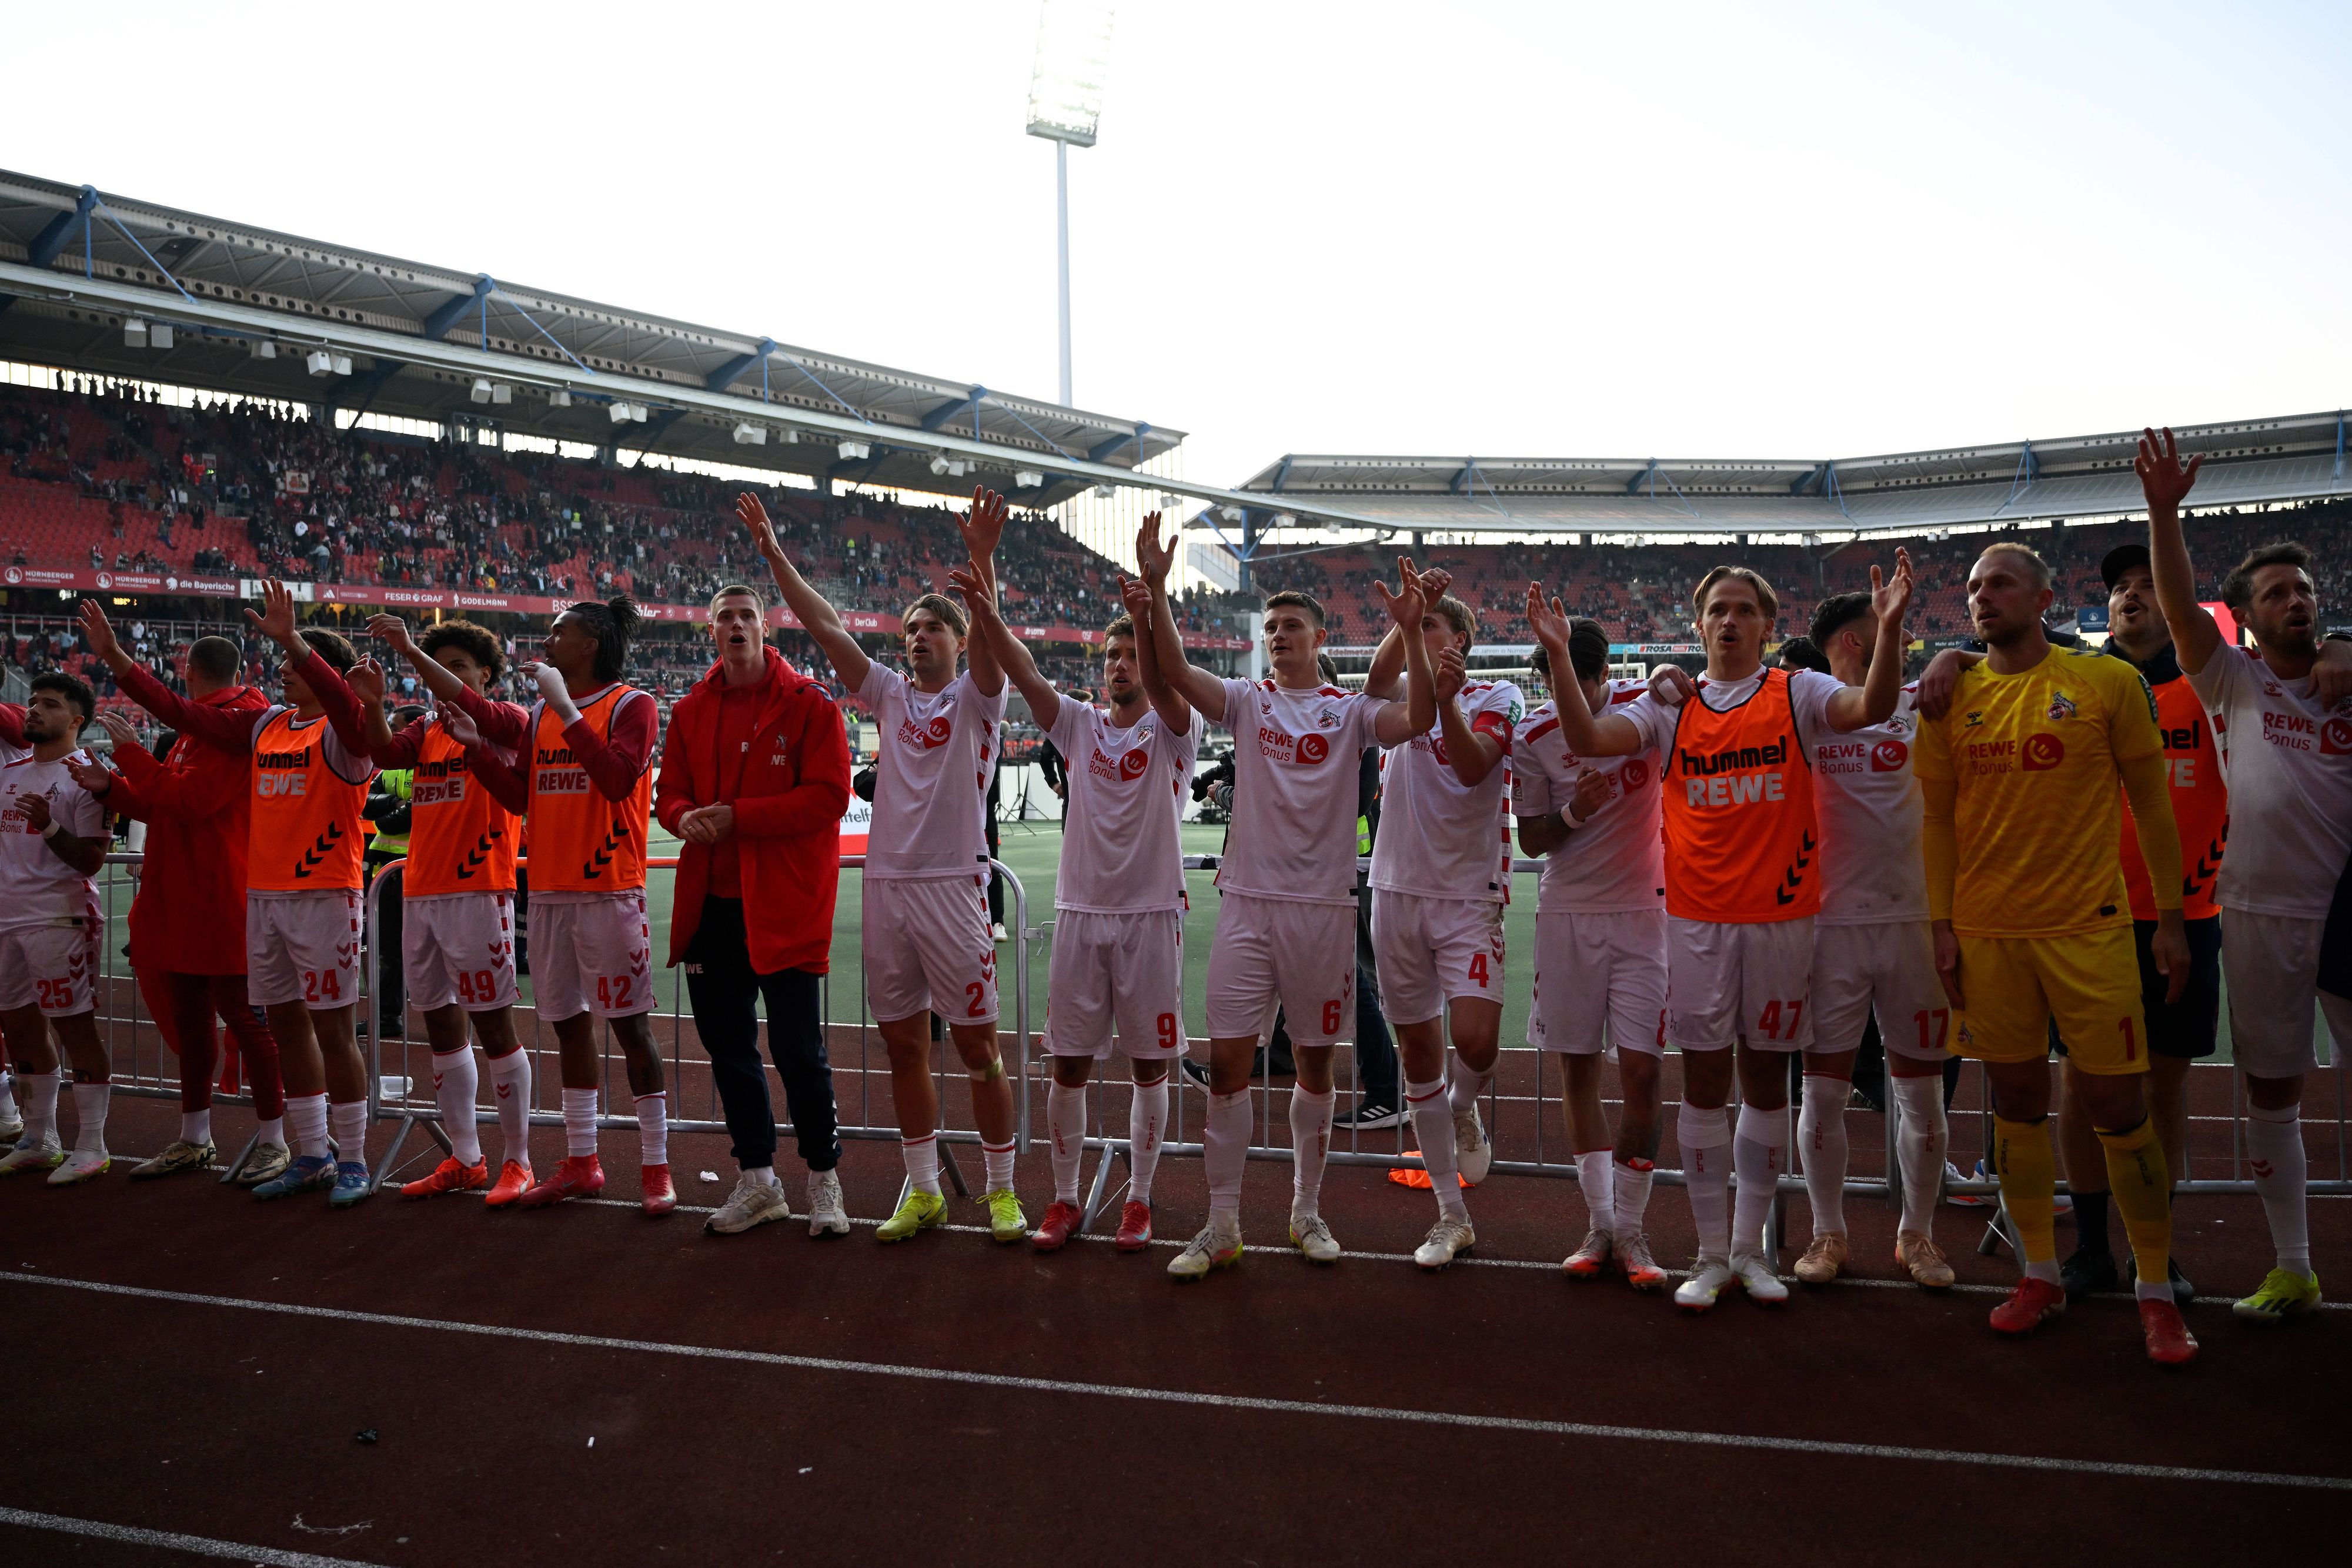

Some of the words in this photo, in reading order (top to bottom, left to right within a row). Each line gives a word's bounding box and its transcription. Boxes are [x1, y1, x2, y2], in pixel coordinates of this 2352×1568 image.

[180, 580, 192, 589] die
[195, 580, 235, 591] Bayerische
[385, 592, 411, 601] FESER
[462, 597, 507, 607] GODELMANN
[855, 618, 865, 626] Der
[865, 618, 877, 627] Club
[2264, 711, 2316, 734] REWE
[1258, 727, 1293, 748] REWE
[1968, 740, 2016, 760] REWE
[1681, 735, 1787, 775] hummel
[1818, 743, 1866, 760] REWE
[538, 771, 587, 791] REWE
[1089, 760, 1116, 781] Bonus
[1819, 761, 1863, 774] Bonus
[258, 773, 306, 795] EWE
[1685, 773, 1786, 807] REWE
[0, 821, 22, 834] Bonus
[1468, 953, 1489, 989] 4
[36, 977, 73, 1008] 25
[305, 969, 340, 1002] 24
[459, 969, 497, 1003] 49
[597, 975, 633, 1009] 42
[965, 981, 986, 1017] 2
[1157, 1012, 1177, 1049] 9
[1322, 999, 1341, 1035] 6
[1758, 1000, 1803, 1040] 47
[1913, 1007, 1949, 1048] 17
[2118, 1016, 2136, 1061] 1
